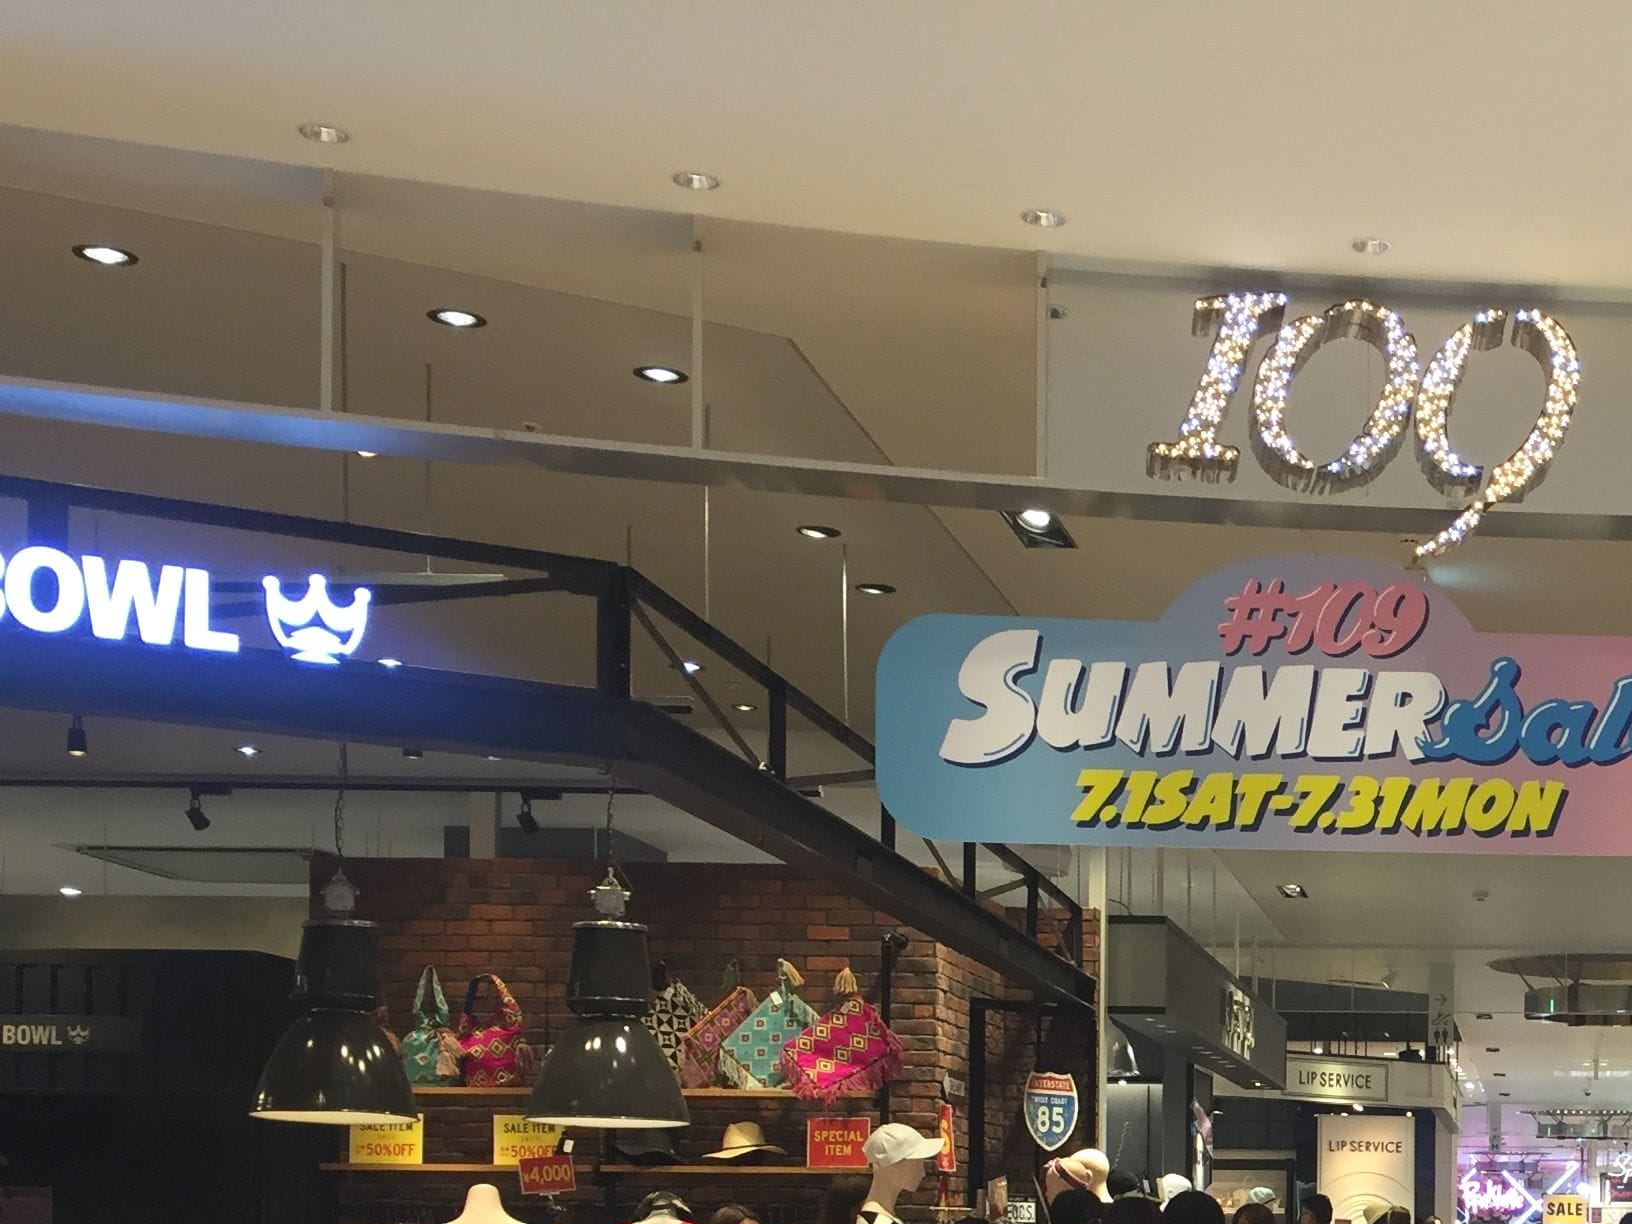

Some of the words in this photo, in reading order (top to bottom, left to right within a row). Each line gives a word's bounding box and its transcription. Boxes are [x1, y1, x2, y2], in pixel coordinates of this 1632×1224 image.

[1146, 290, 1583, 560] 109
[0, 546, 239, 652] OWL
[1217, 578, 1430, 659] #109
[938, 629, 1450, 768] SUMMER
[2, 1025, 63, 1045] BOWL
[1298, 1070, 1318, 1085] LIP
[1319, 1072, 1372, 1089] SERVICE
[503, 1123, 528, 1134] SALE
[532, 1123, 555, 1134] ITEM
[1037, 1105, 1065, 1134] 85
[814, 1130, 864, 1142] SPECIAL
[366, 1143, 416, 1156] 50%OFF
[825, 1144, 852, 1156] ITEM
[1328, 1140, 1347, 1152] LIP
[1349, 1141, 1402, 1153] SERVICE
[1546, 1202, 1583, 1217] SALE
